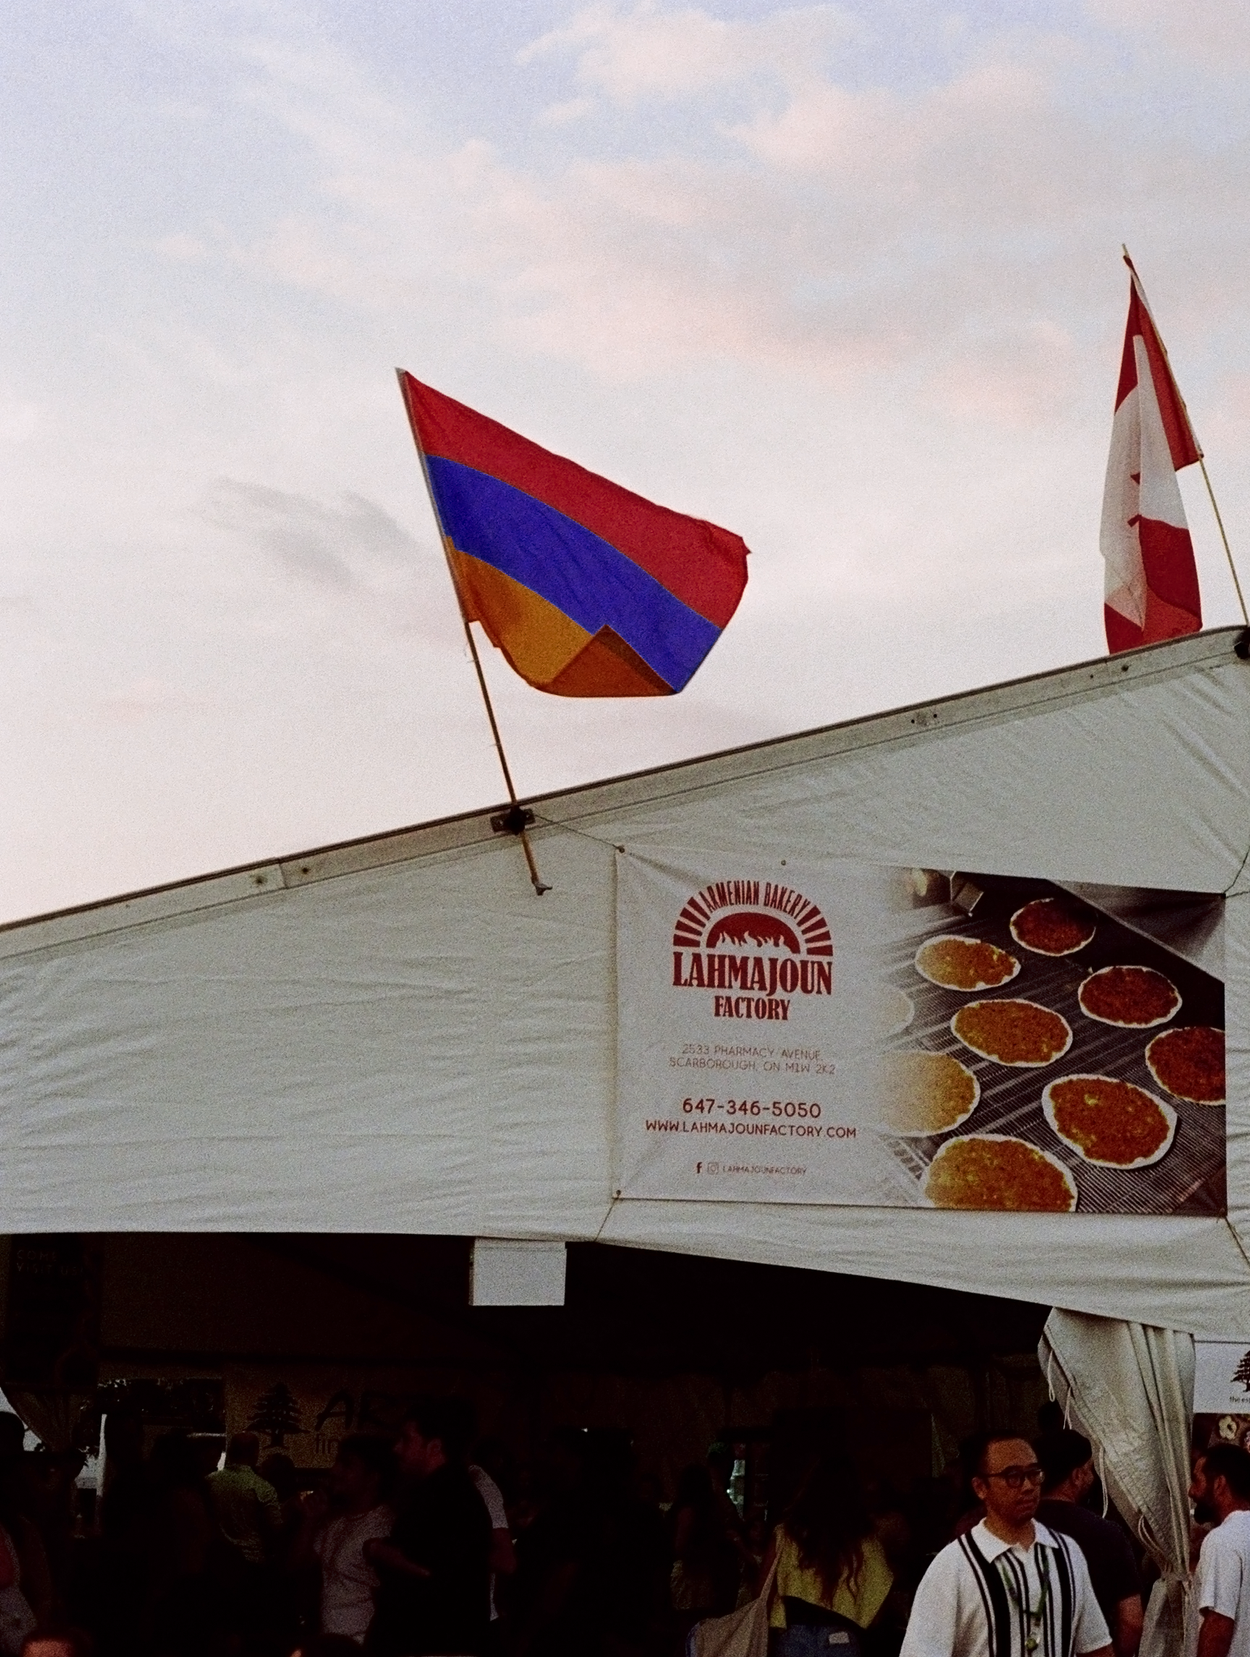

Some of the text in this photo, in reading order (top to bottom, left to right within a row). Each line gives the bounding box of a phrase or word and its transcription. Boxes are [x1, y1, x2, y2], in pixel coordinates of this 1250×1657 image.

[699, 880, 812, 920] ARMENIAN BAKERY
[672, 951, 833, 997] LAHMAJOUN
[714, 995, 791, 1021] FACTORY
[682, 1043, 710, 1055] 2533
[714, 1045, 775, 1059] PHARMACY
[763, 1061, 781, 1072] ON
[816, 1064, 836, 1075] 2K2
[682, 1097, 822, 1119] 647-346-5050
[645, 1119, 857, 1139] WWW.LAHMAJOUNFACTORY.COM
